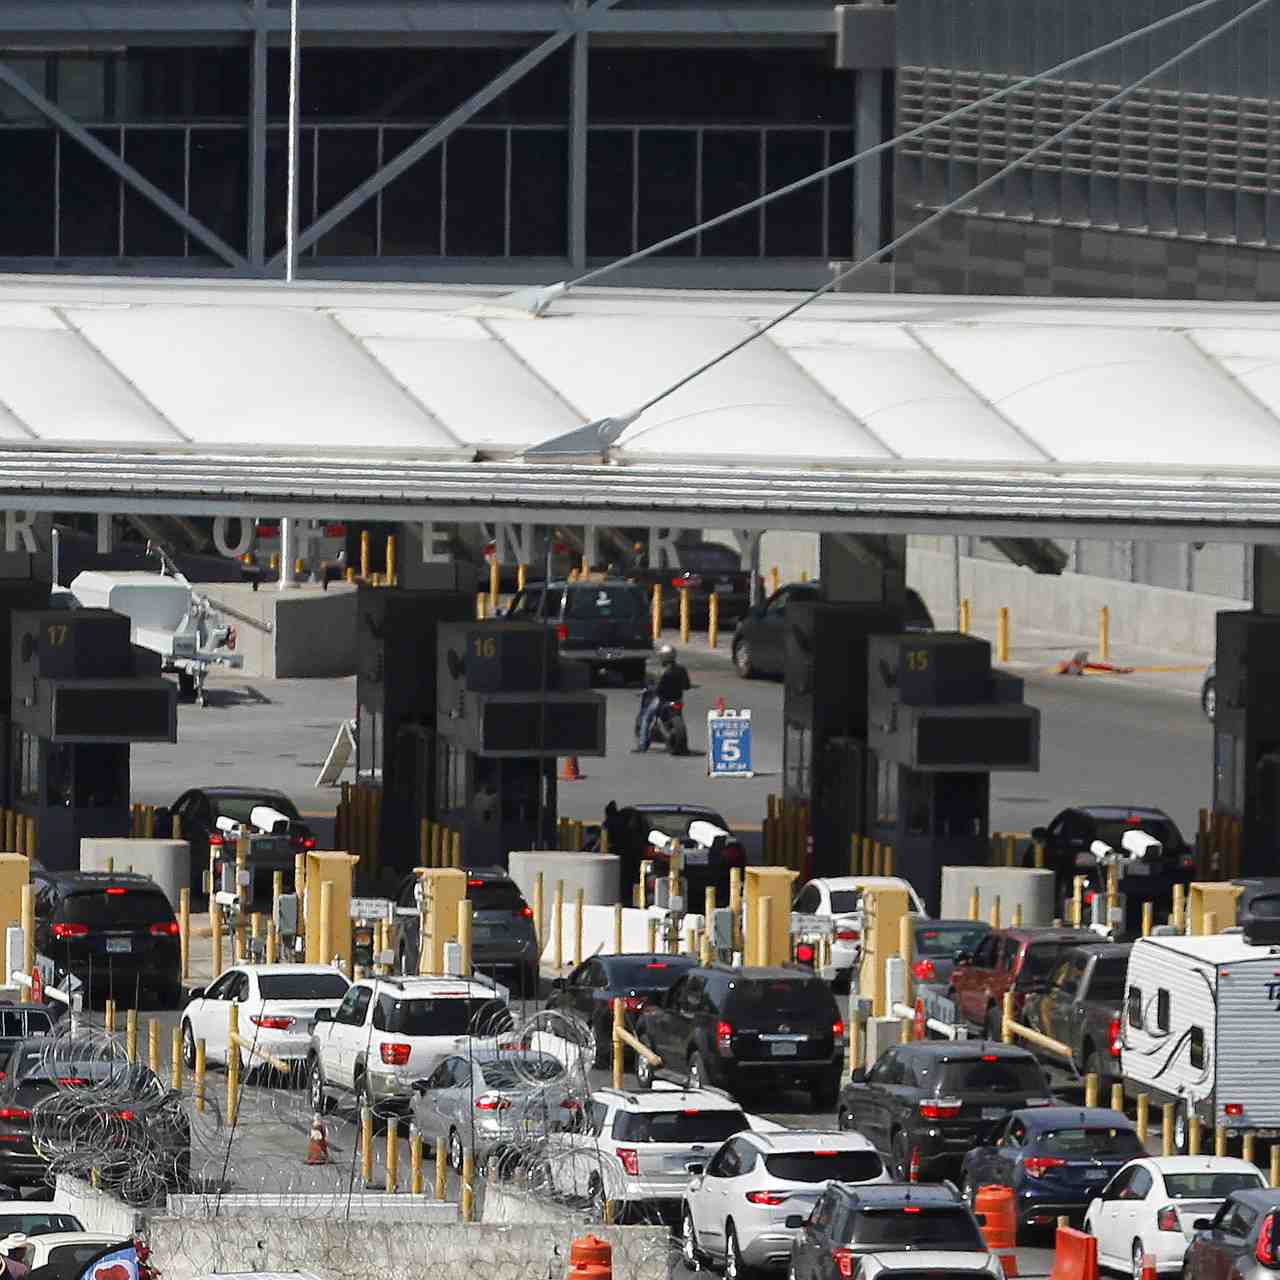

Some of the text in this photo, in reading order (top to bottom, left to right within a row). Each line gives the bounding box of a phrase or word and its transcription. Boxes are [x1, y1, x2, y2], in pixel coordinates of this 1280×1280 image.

[48, 624, 67, 645] 17
[473, 638, 497, 658] 16
[721, 738, 741, 762] 5
